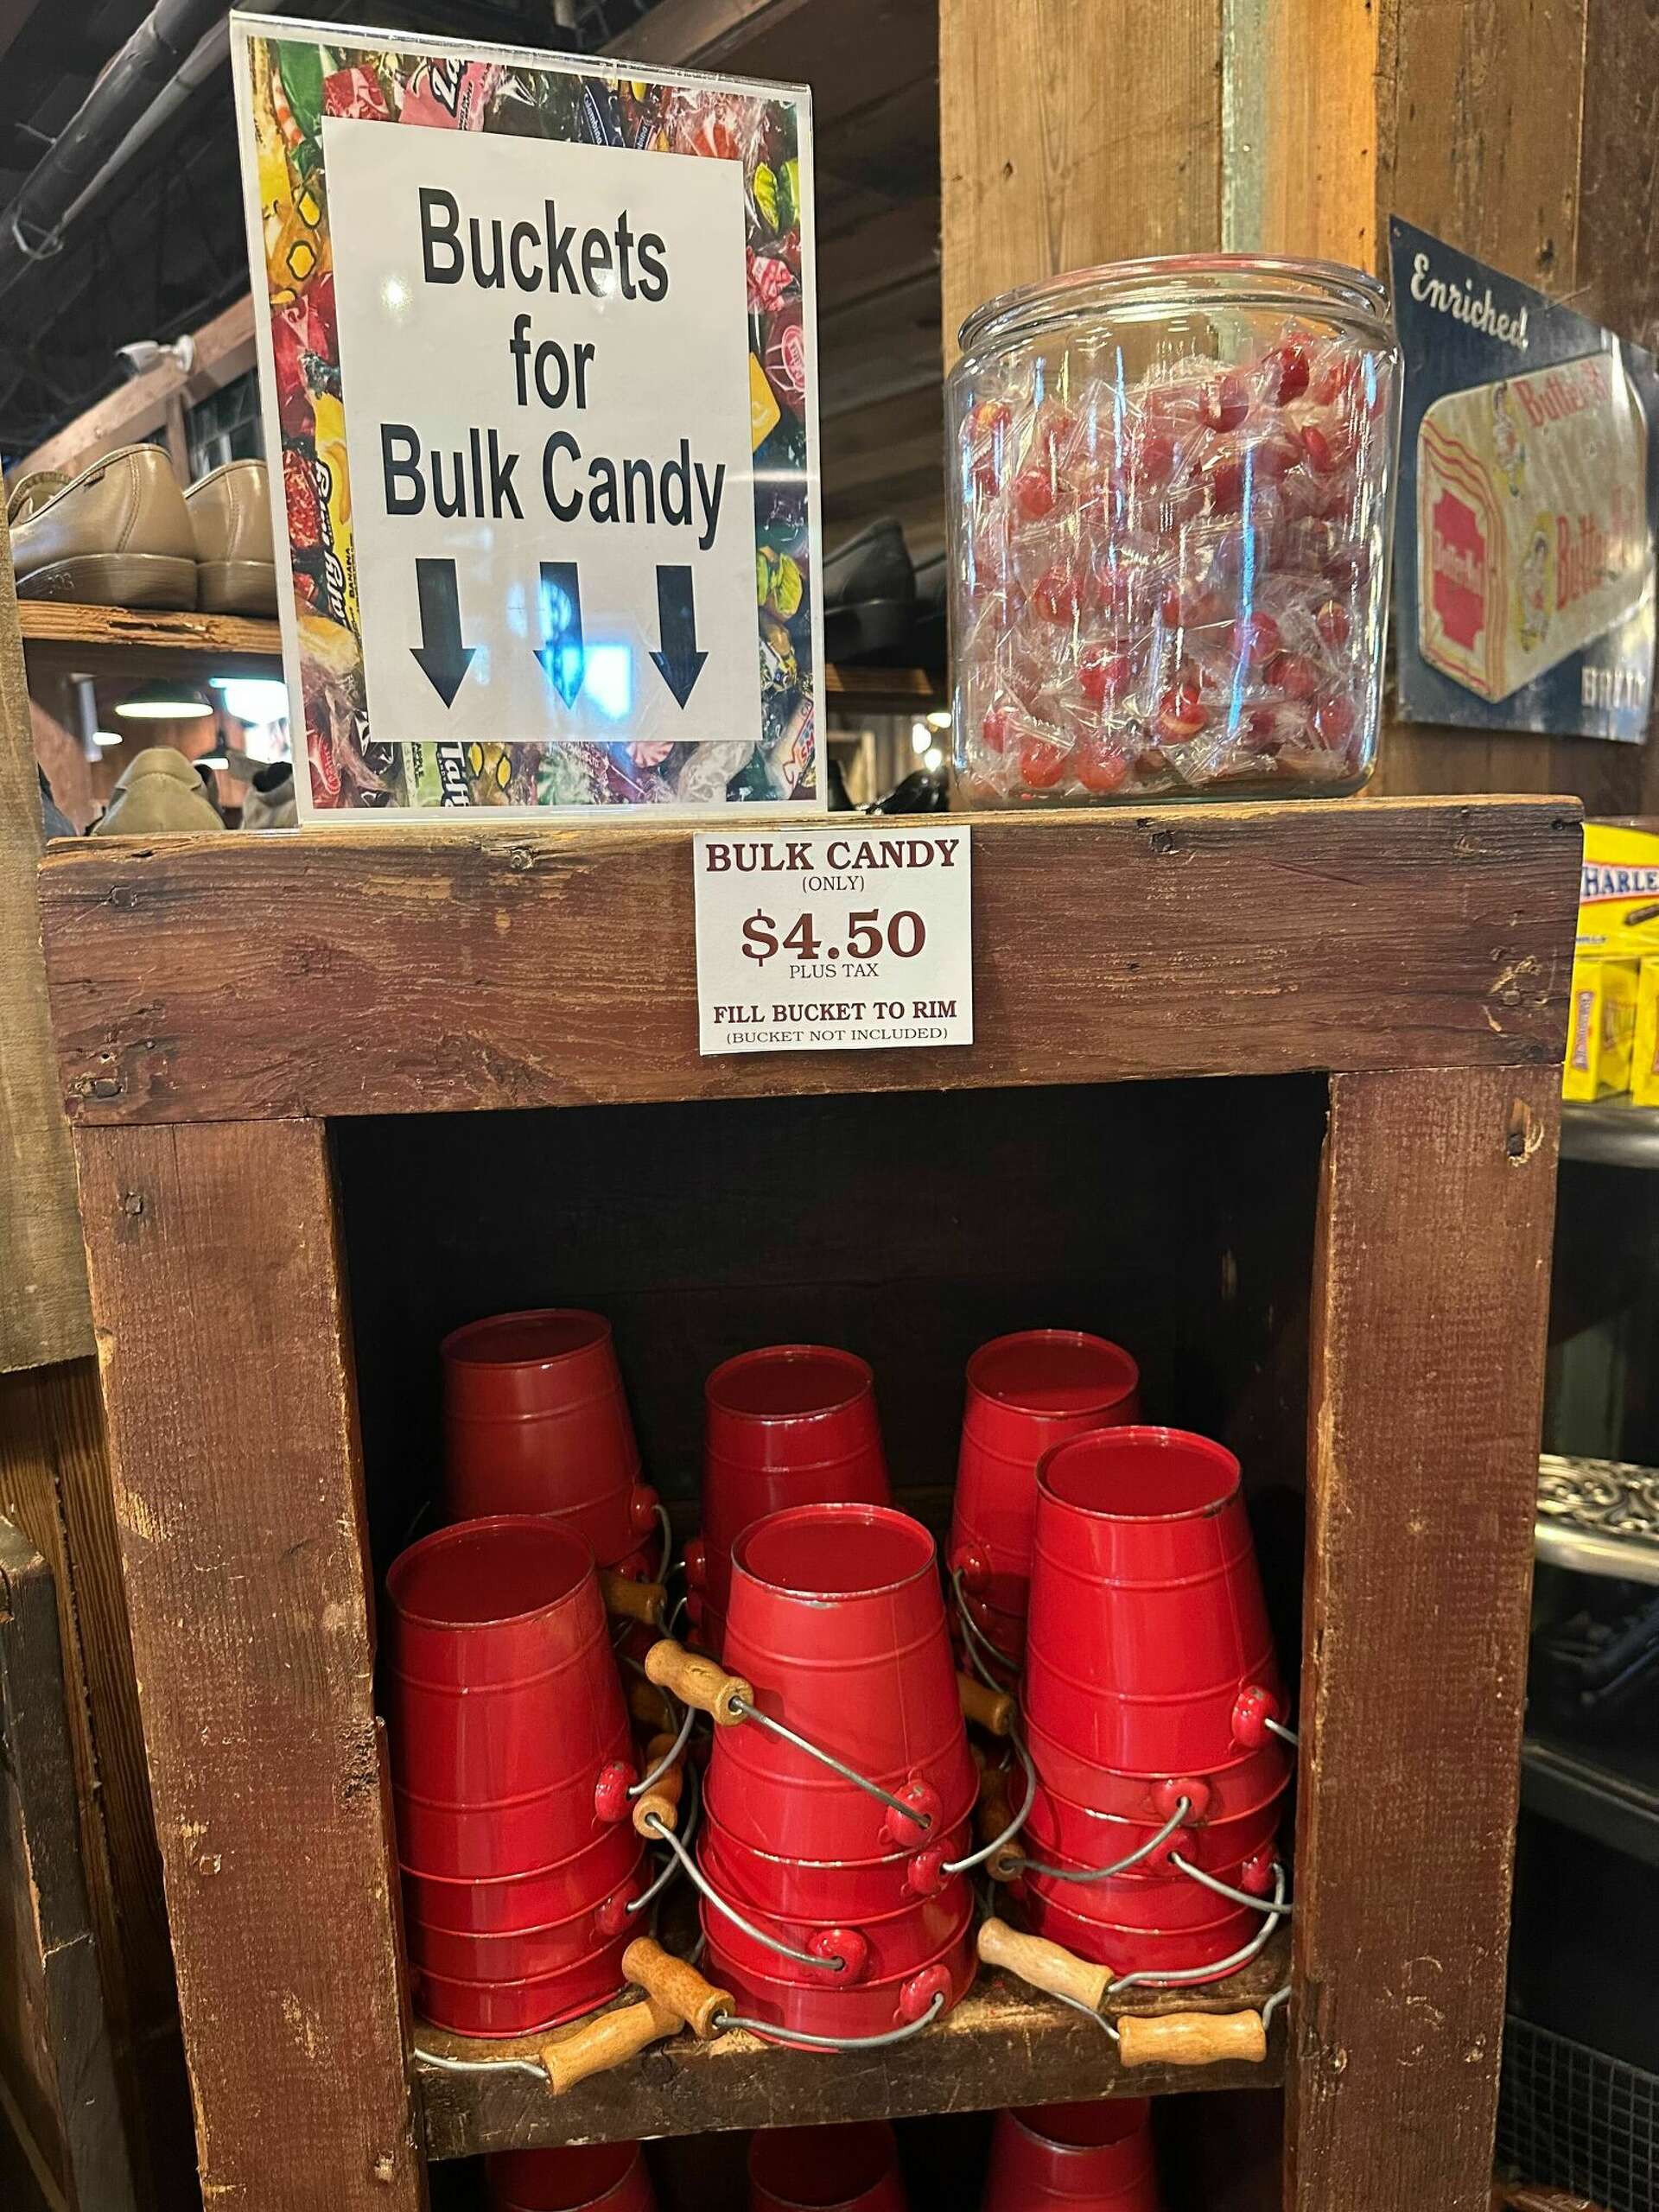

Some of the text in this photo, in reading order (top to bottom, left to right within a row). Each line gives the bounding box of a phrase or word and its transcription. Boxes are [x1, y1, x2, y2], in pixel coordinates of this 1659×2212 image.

[418, 187, 669, 302] Buckets
[510, 314, 595, 410] for
[380, 423, 524, 519] Bulk
[542, 430, 726, 550] Candy
[705, 839, 961, 873] BULK CANDY
[802, 875, 865, 893] (ONLY)
[741, 908, 926, 967] $4.50
[790, 963, 880, 979] PLUS TAX
[713, 1000, 957, 1024] FILL BUCKET TO RIM
[727, 1027, 948, 1045] (BUCKET NOT INCLUDED)
